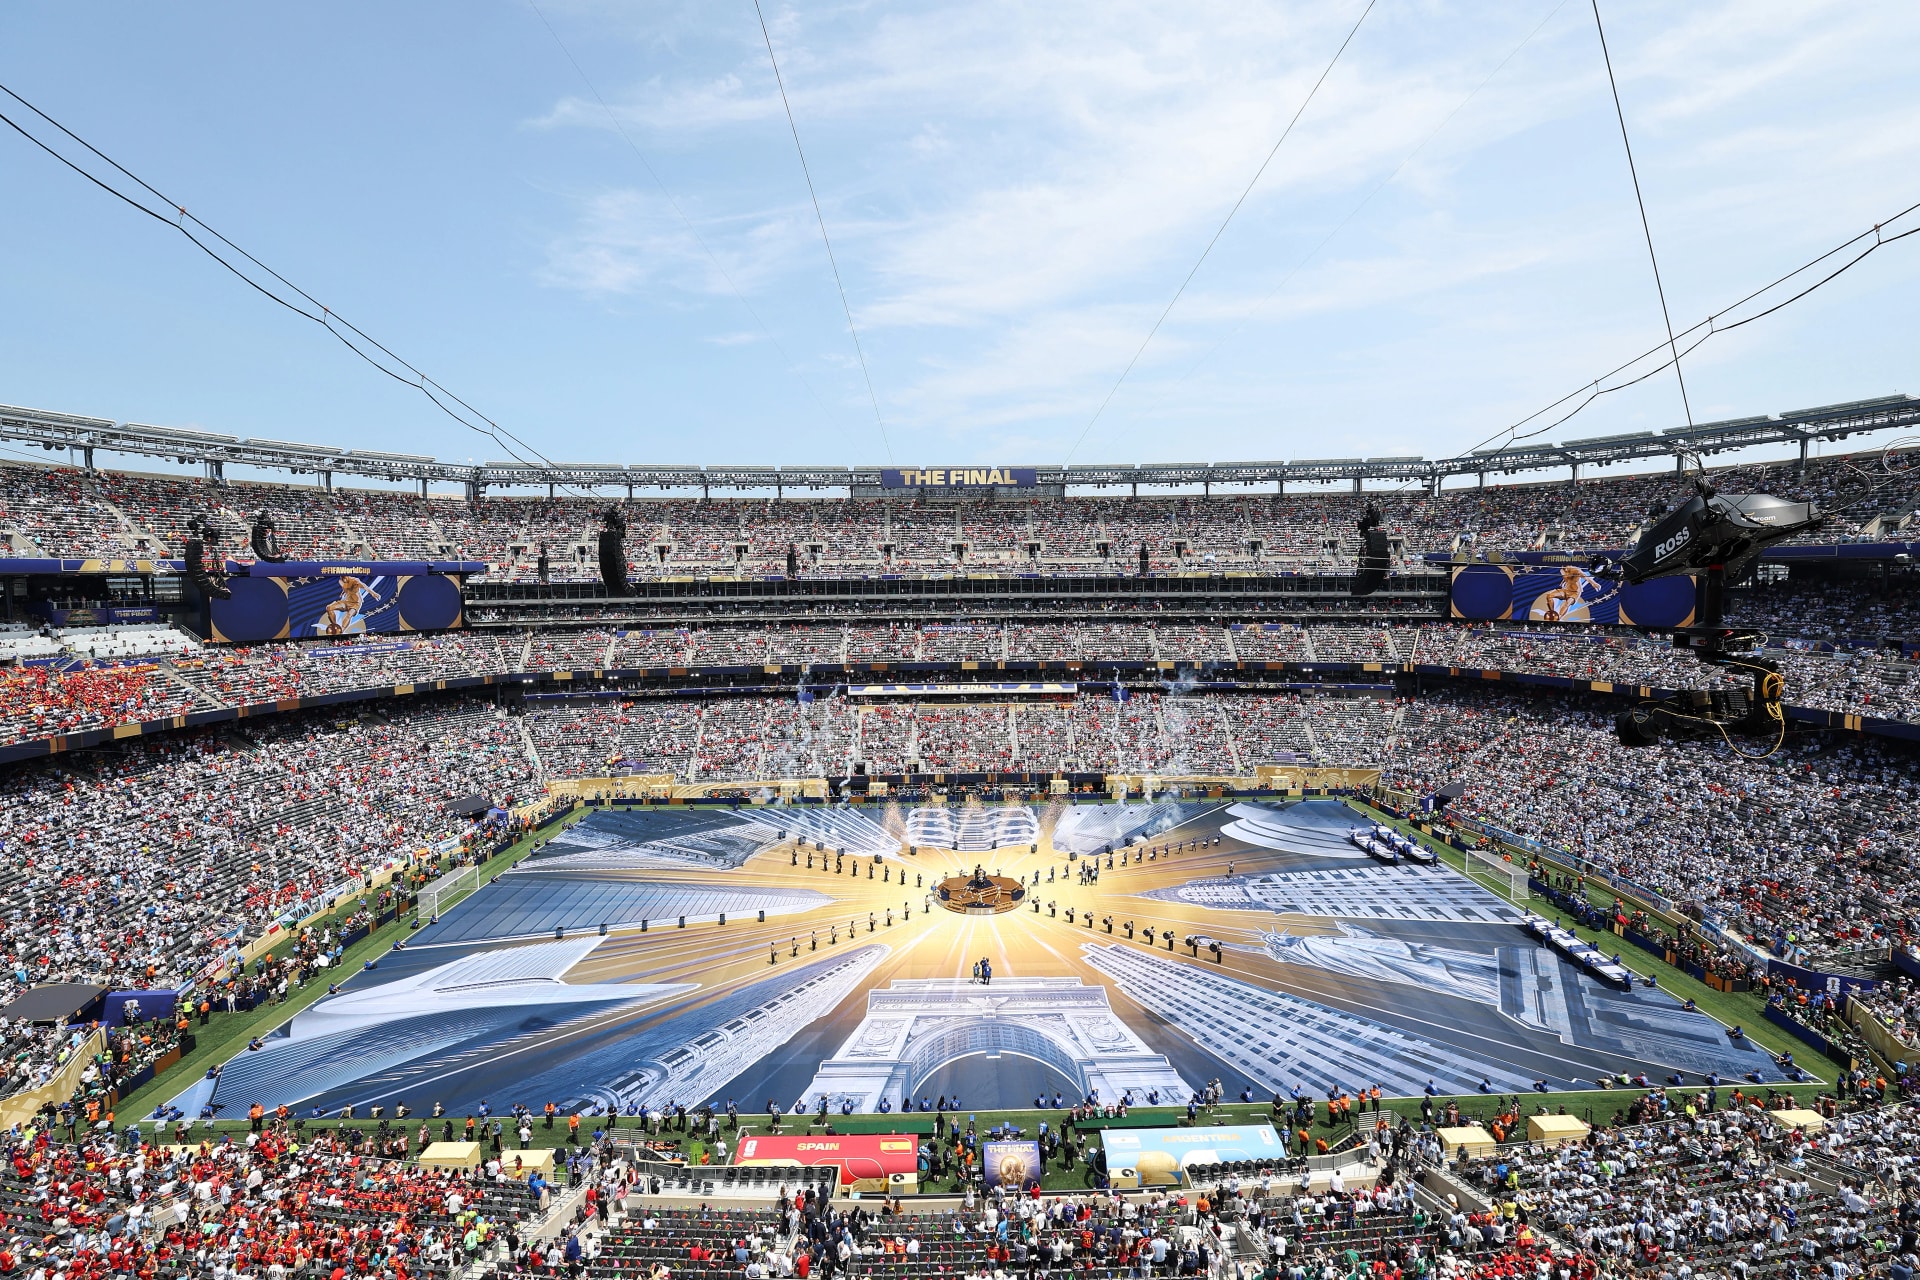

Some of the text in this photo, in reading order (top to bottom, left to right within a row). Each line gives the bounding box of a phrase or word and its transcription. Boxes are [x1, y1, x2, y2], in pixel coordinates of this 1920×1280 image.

[899, 469, 1018, 486] THE FINAL
[1655, 526, 1690, 559] ROSS
[320, 566, 371, 575] #FIFAWorldCup
[1162, 1133, 1241, 1143] ARGENTINA
[796, 1142, 840, 1151] SPAIN
